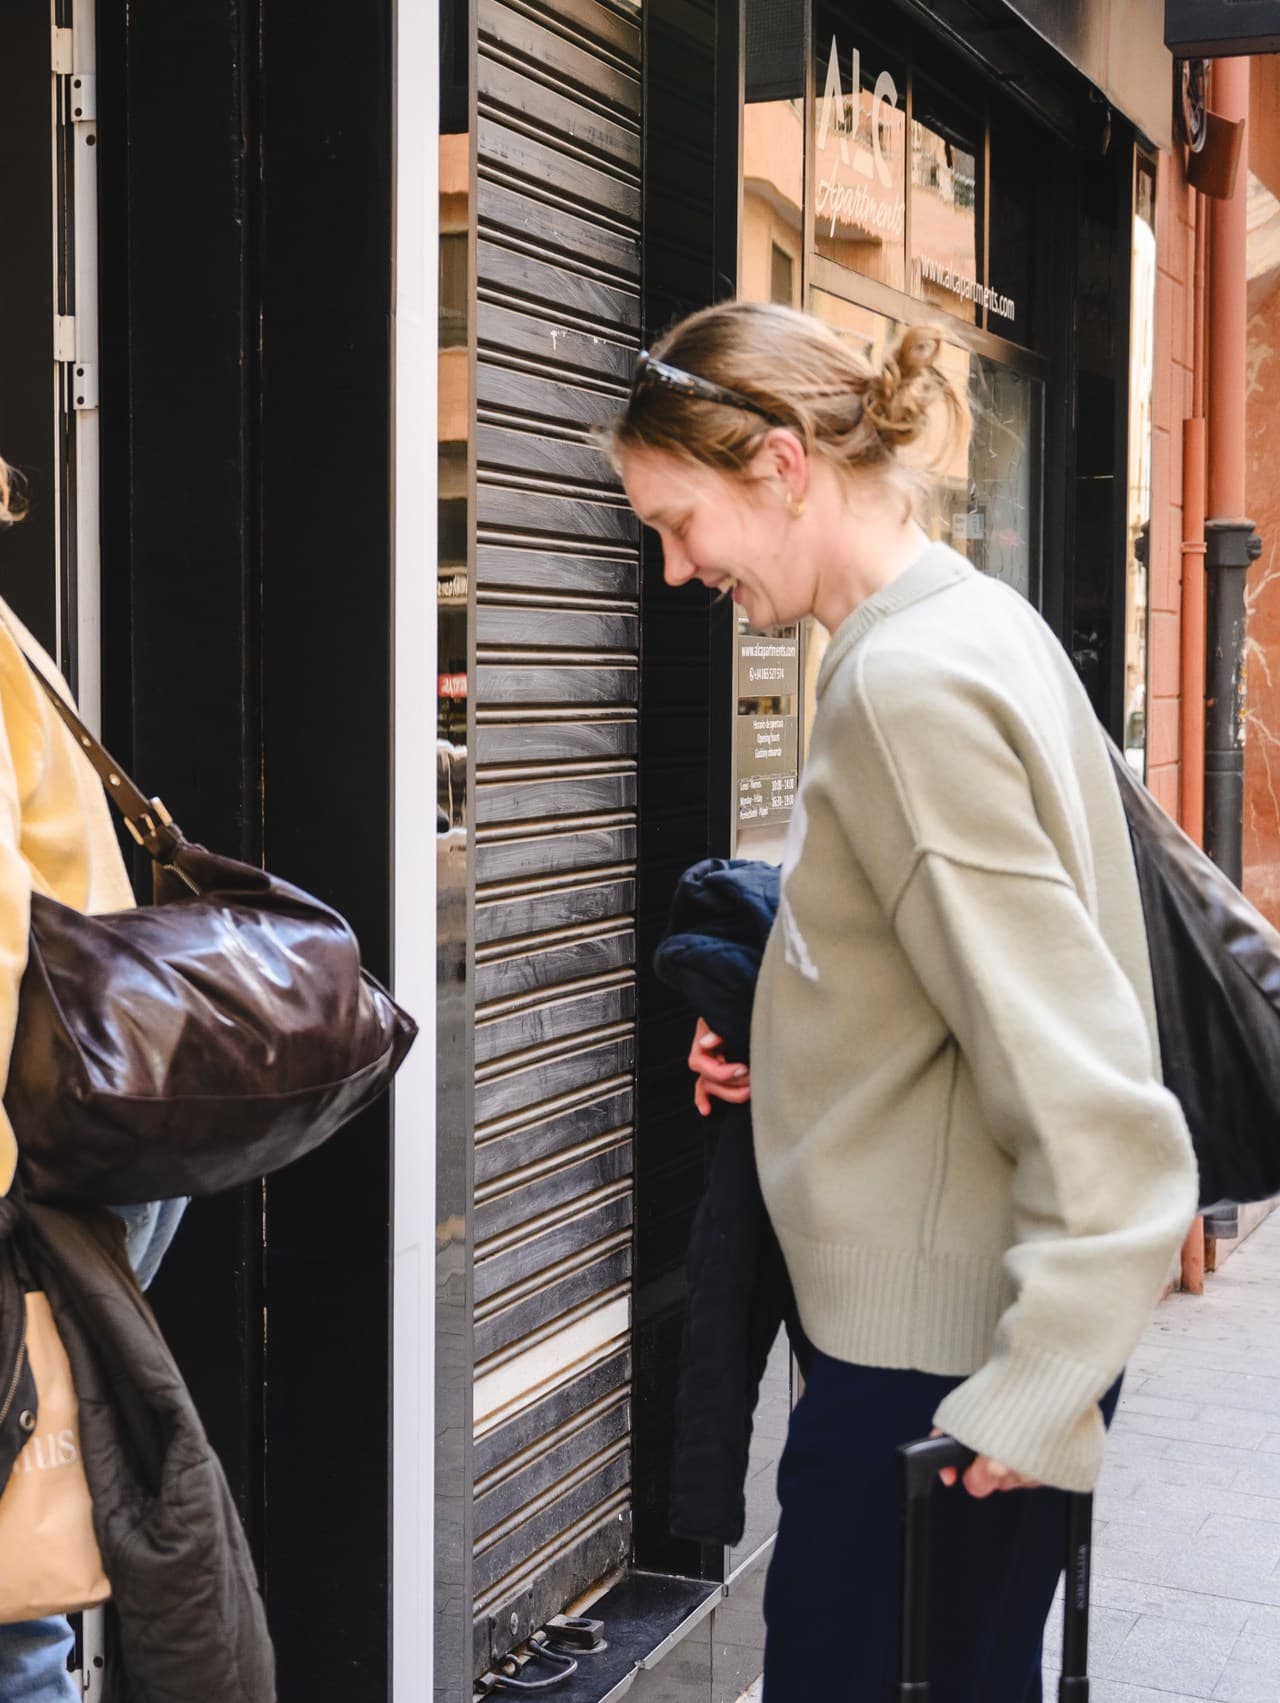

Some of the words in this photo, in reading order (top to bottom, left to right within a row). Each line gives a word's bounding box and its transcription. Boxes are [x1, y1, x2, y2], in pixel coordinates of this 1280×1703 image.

[816, 33, 898, 189] ALC
[815, 160, 906, 238] Apartments
[922, 256, 1016, 321] www.alcapartments.com
